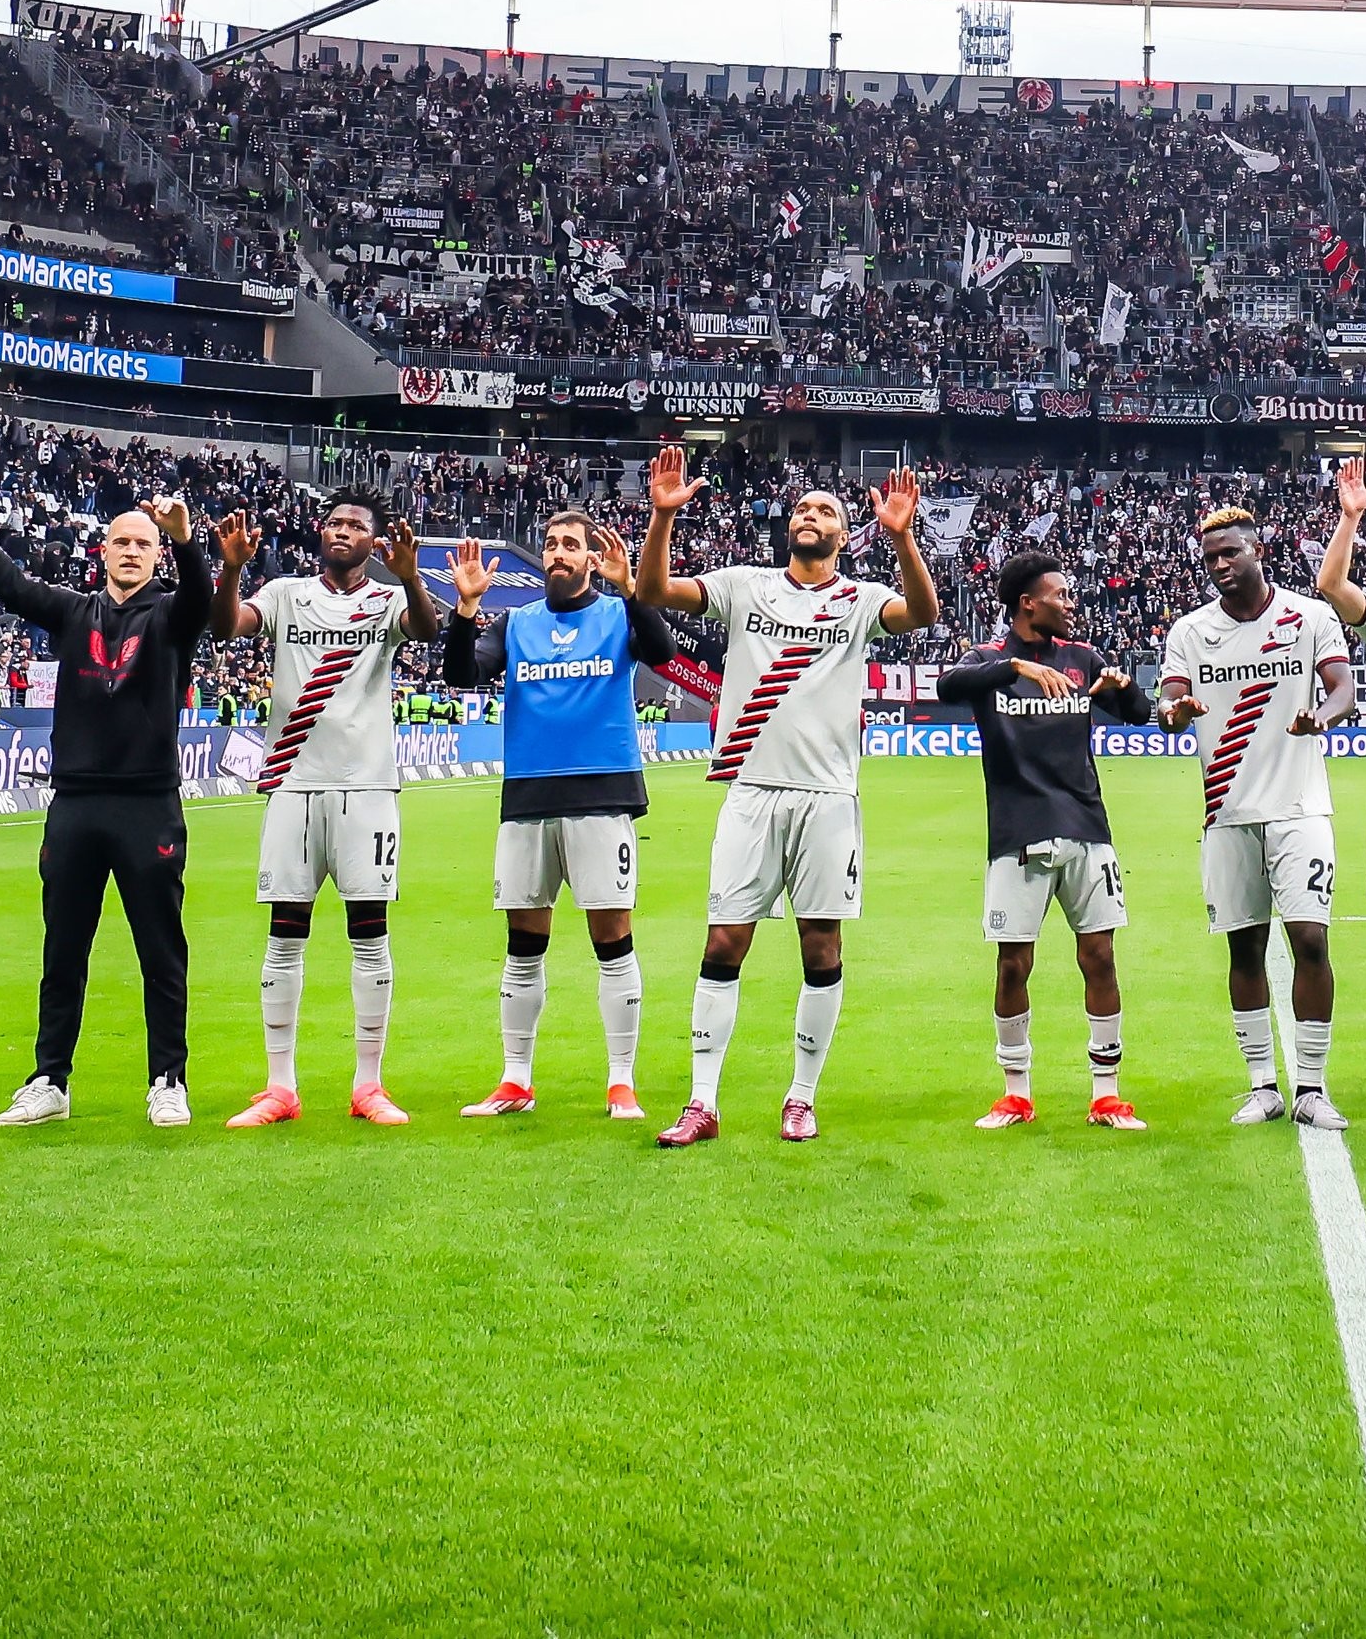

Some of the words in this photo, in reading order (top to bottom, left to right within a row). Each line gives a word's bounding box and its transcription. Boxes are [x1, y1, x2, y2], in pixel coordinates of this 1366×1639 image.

[455, 253, 533, 275] WHITE
[690, 314, 728, 333] MOTOR
[747, 314, 771, 334] CITY
[0, 329, 148, 382] RoboMarkets
[575, 380, 628, 400] united
[649, 380, 761, 398] COMMANDO
[663, 397, 746, 415] GIESSEN
[286, 624, 388, 646] Barmenia
[745, 612, 851, 644] Barmenia
[515, 654, 614, 683] Barmenia
[1198, 656, 1304, 685] Barmenia
[996, 694, 1091, 717] Barmenia
[865, 724, 983, 757] arkets
[1092, 726, 1198, 756] fessio
[372, 831, 396, 866] 12
[617, 842, 631, 875] 9
[845, 849, 857, 885] 4
